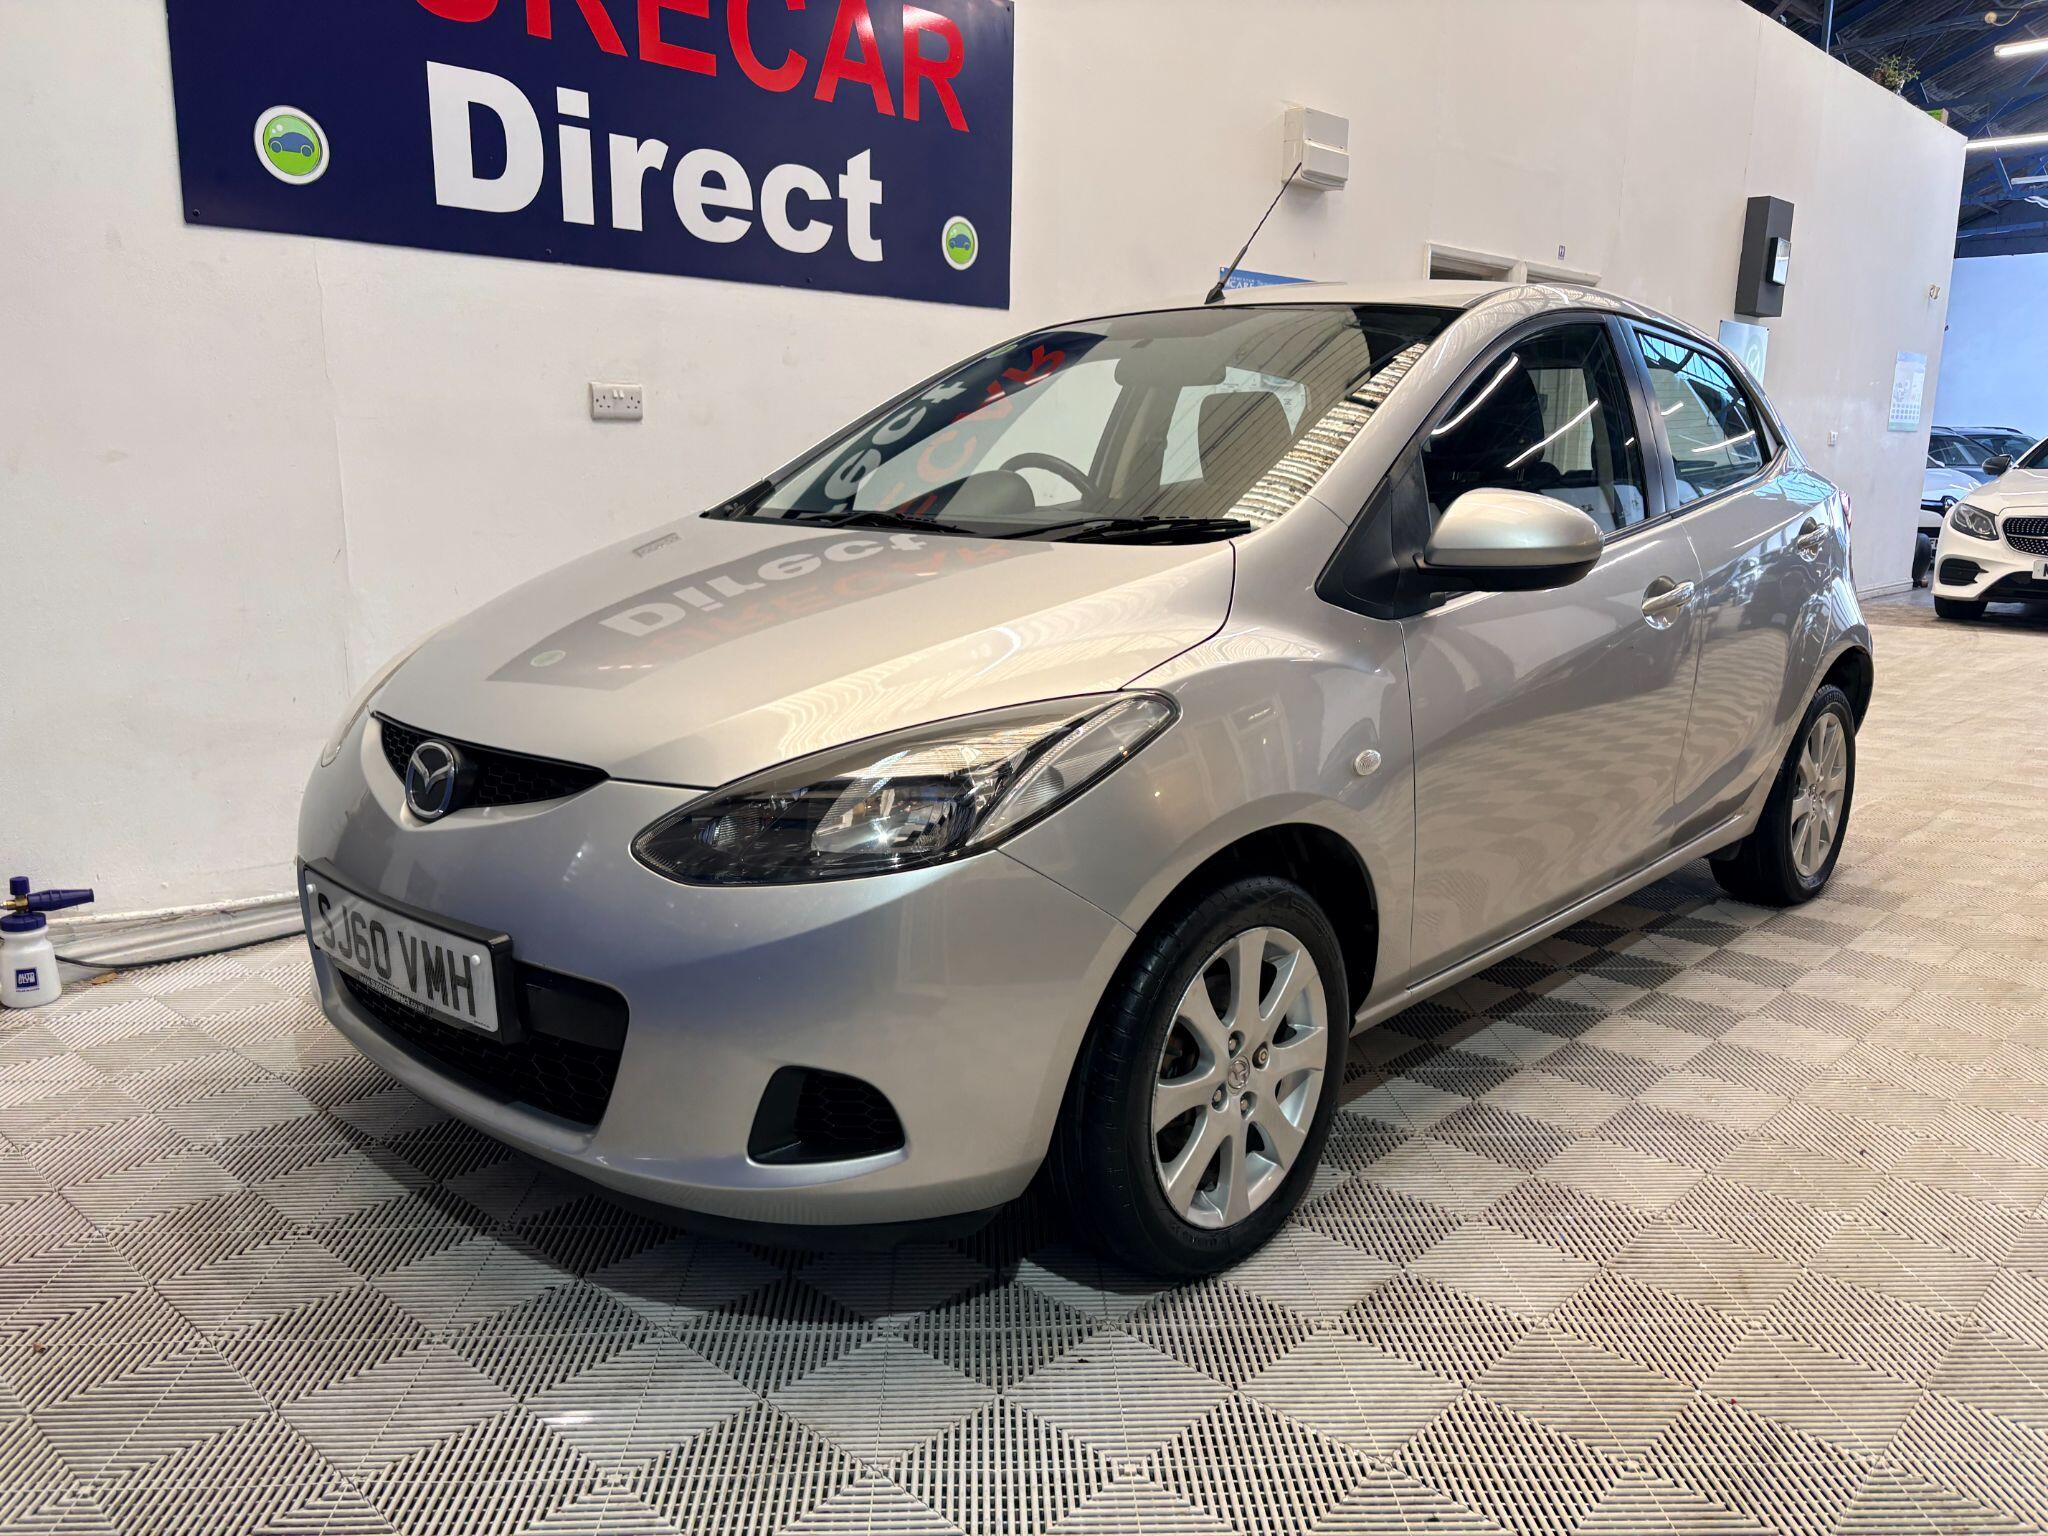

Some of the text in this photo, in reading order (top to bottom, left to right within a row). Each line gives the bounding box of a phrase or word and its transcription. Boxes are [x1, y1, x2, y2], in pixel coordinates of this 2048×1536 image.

[426, 60, 883, 262] Direct
[318, 893, 391, 980] SJ60
[398, 931, 476, 1017] VMH
